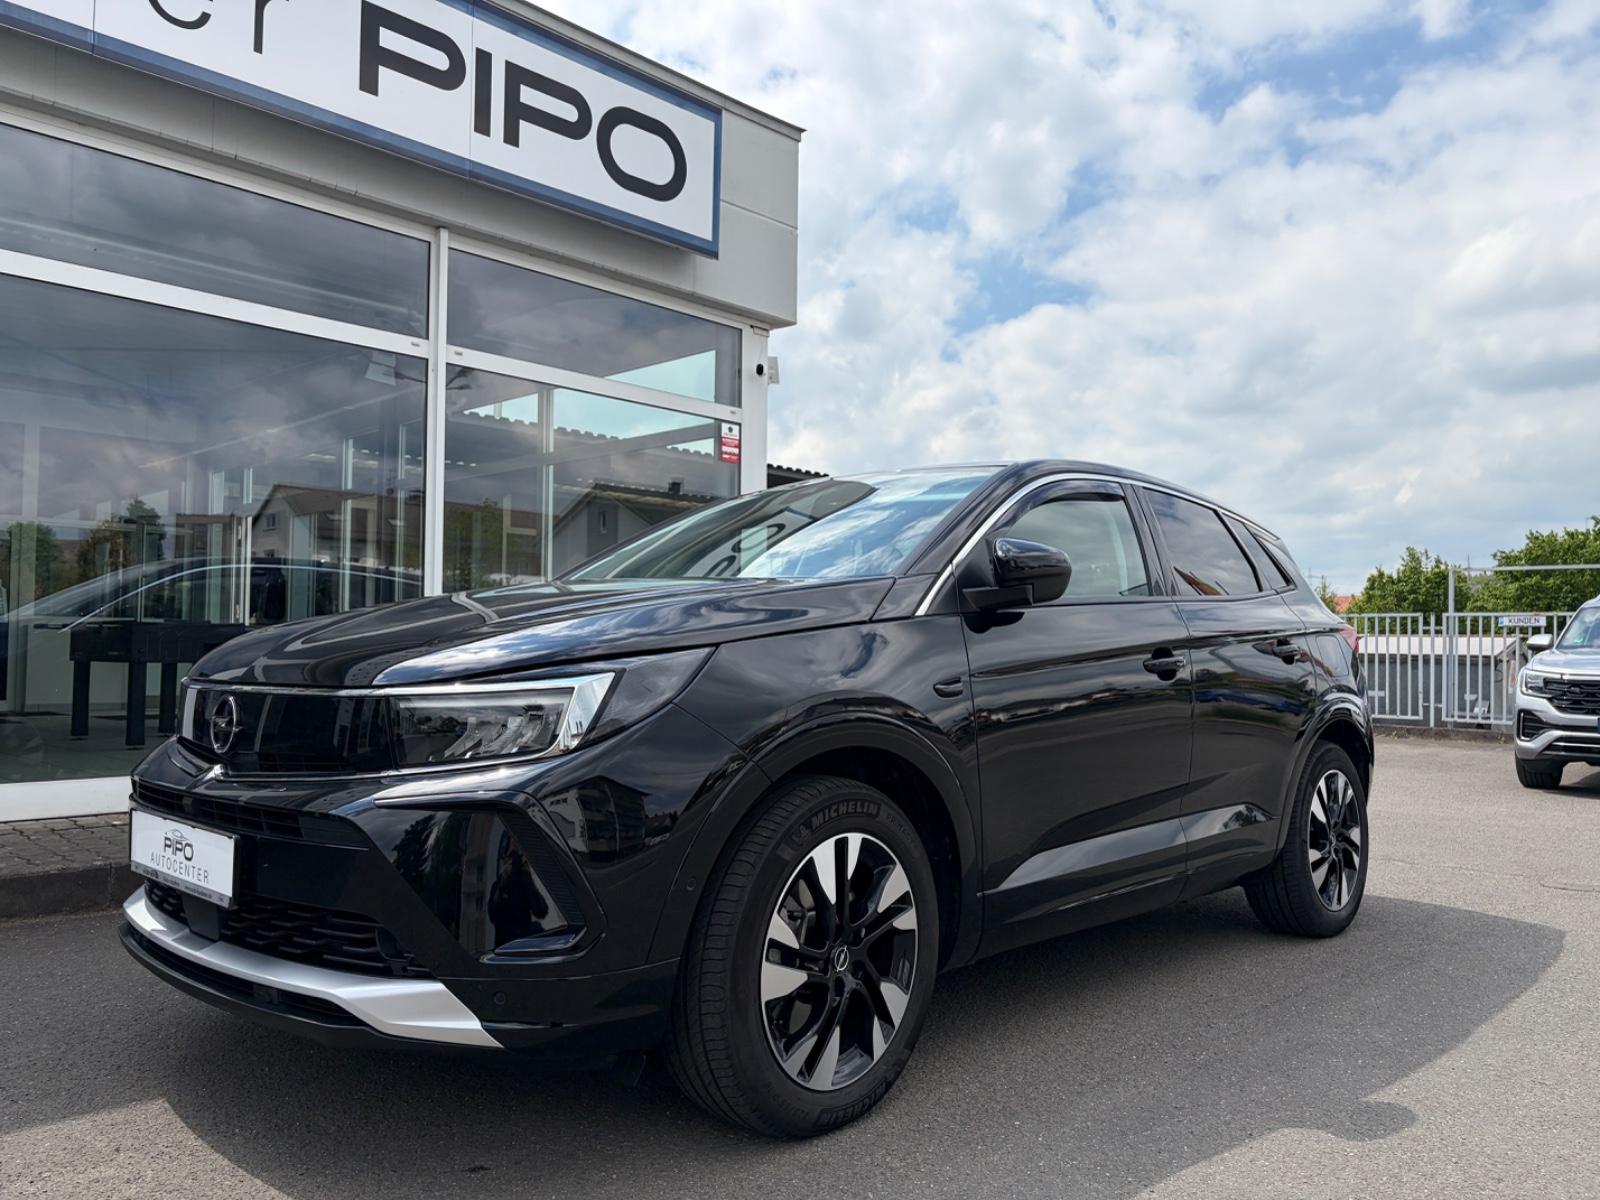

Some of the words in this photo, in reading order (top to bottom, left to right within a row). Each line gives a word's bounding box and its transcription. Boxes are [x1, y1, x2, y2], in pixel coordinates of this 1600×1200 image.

[359, 0, 688, 202] PIPO
[1508, 616, 1540, 625] KUNDEN
[811, 800, 879, 829] MICHELIN
[164, 836, 194, 862] PIPO
[150, 852, 209, 884] AUTOCENTER
